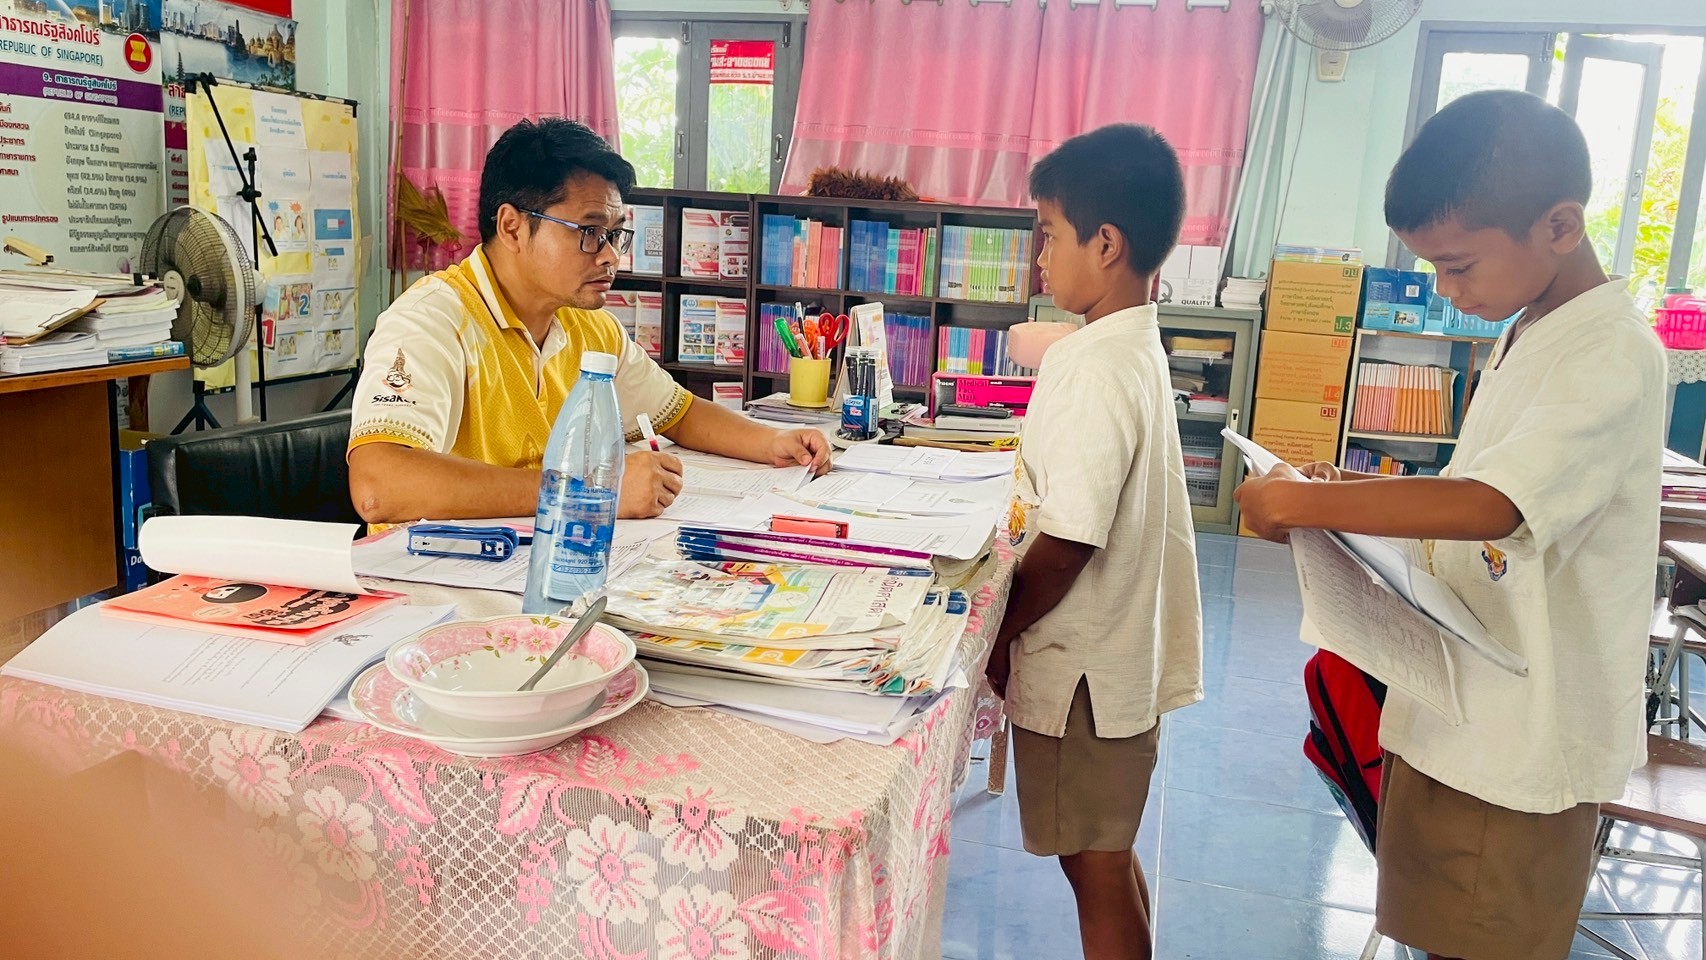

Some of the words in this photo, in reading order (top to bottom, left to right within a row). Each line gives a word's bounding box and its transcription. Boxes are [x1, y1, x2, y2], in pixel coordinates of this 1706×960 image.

[41, 46, 51, 57] OF
[57, 48, 103, 67] SINGAPORE)
[43, 72, 52, 83] 9.
[0, 119, 30, 130] มืองหลวง
[299, 294, 309, 315] 2
[130, 555, 143, 567] Do
